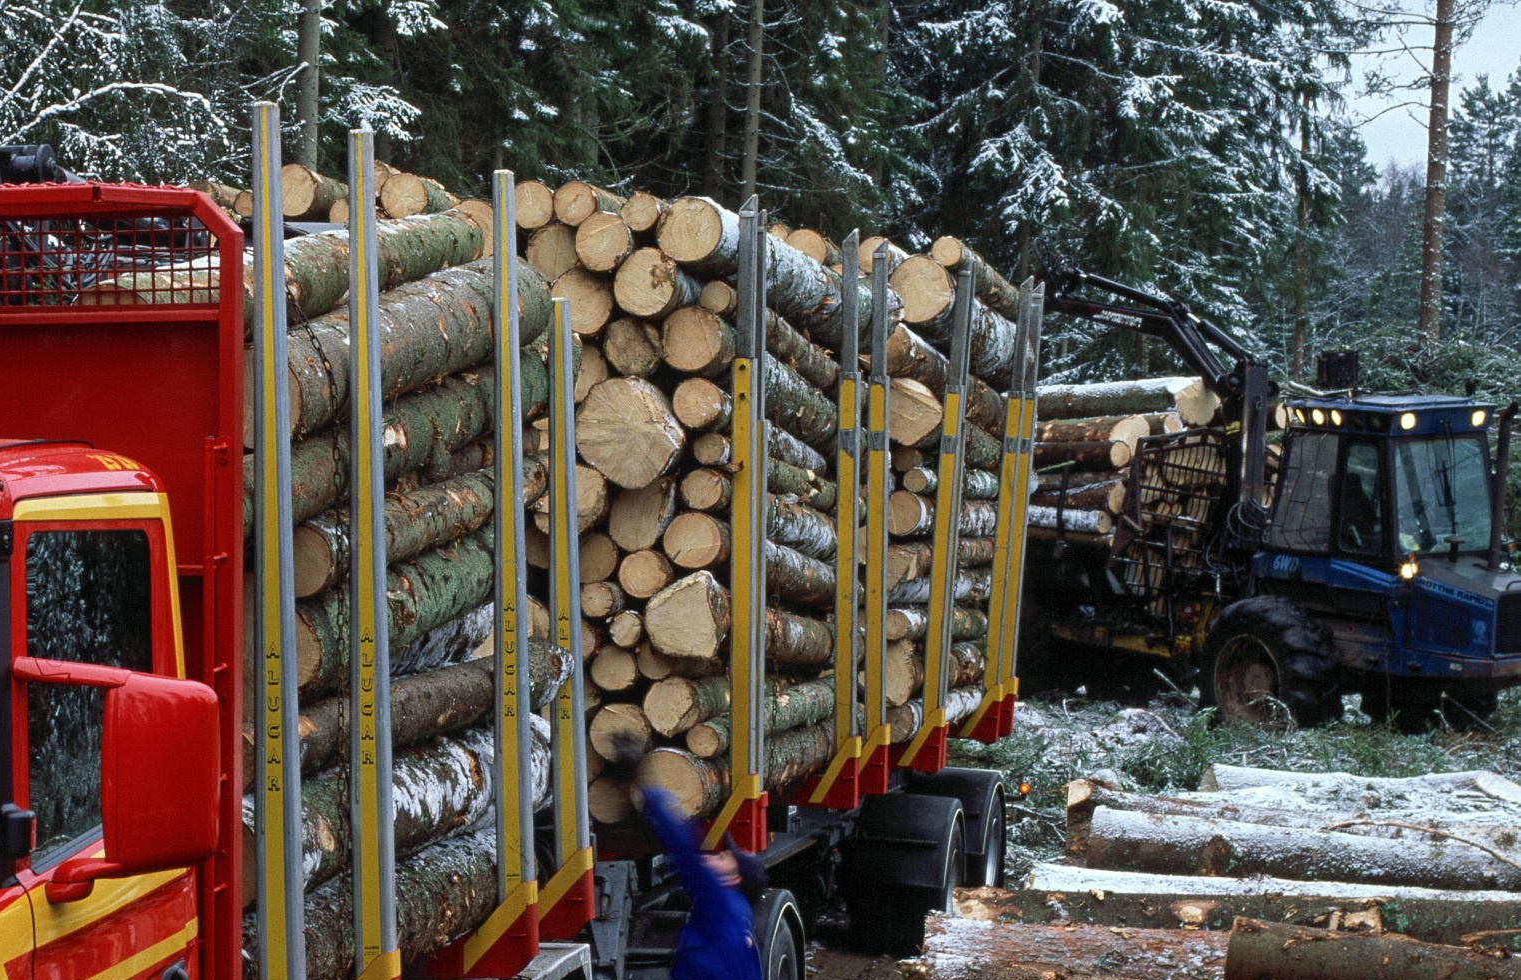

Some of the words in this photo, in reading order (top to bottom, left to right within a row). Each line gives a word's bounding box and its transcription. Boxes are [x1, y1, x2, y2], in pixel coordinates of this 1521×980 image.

[1274, 554, 1299, 571] 6WD
[1419, 578, 1456, 595] ROTTNE
[1457, 590, 1486, 605] RAPID
[360, 626, 374, 764] ALUCAR
[503, 597, 516, 717] ALUCAR
[558, 609, 571, 719] ALAR
[266, 641, 281, 791] ALUCAR
